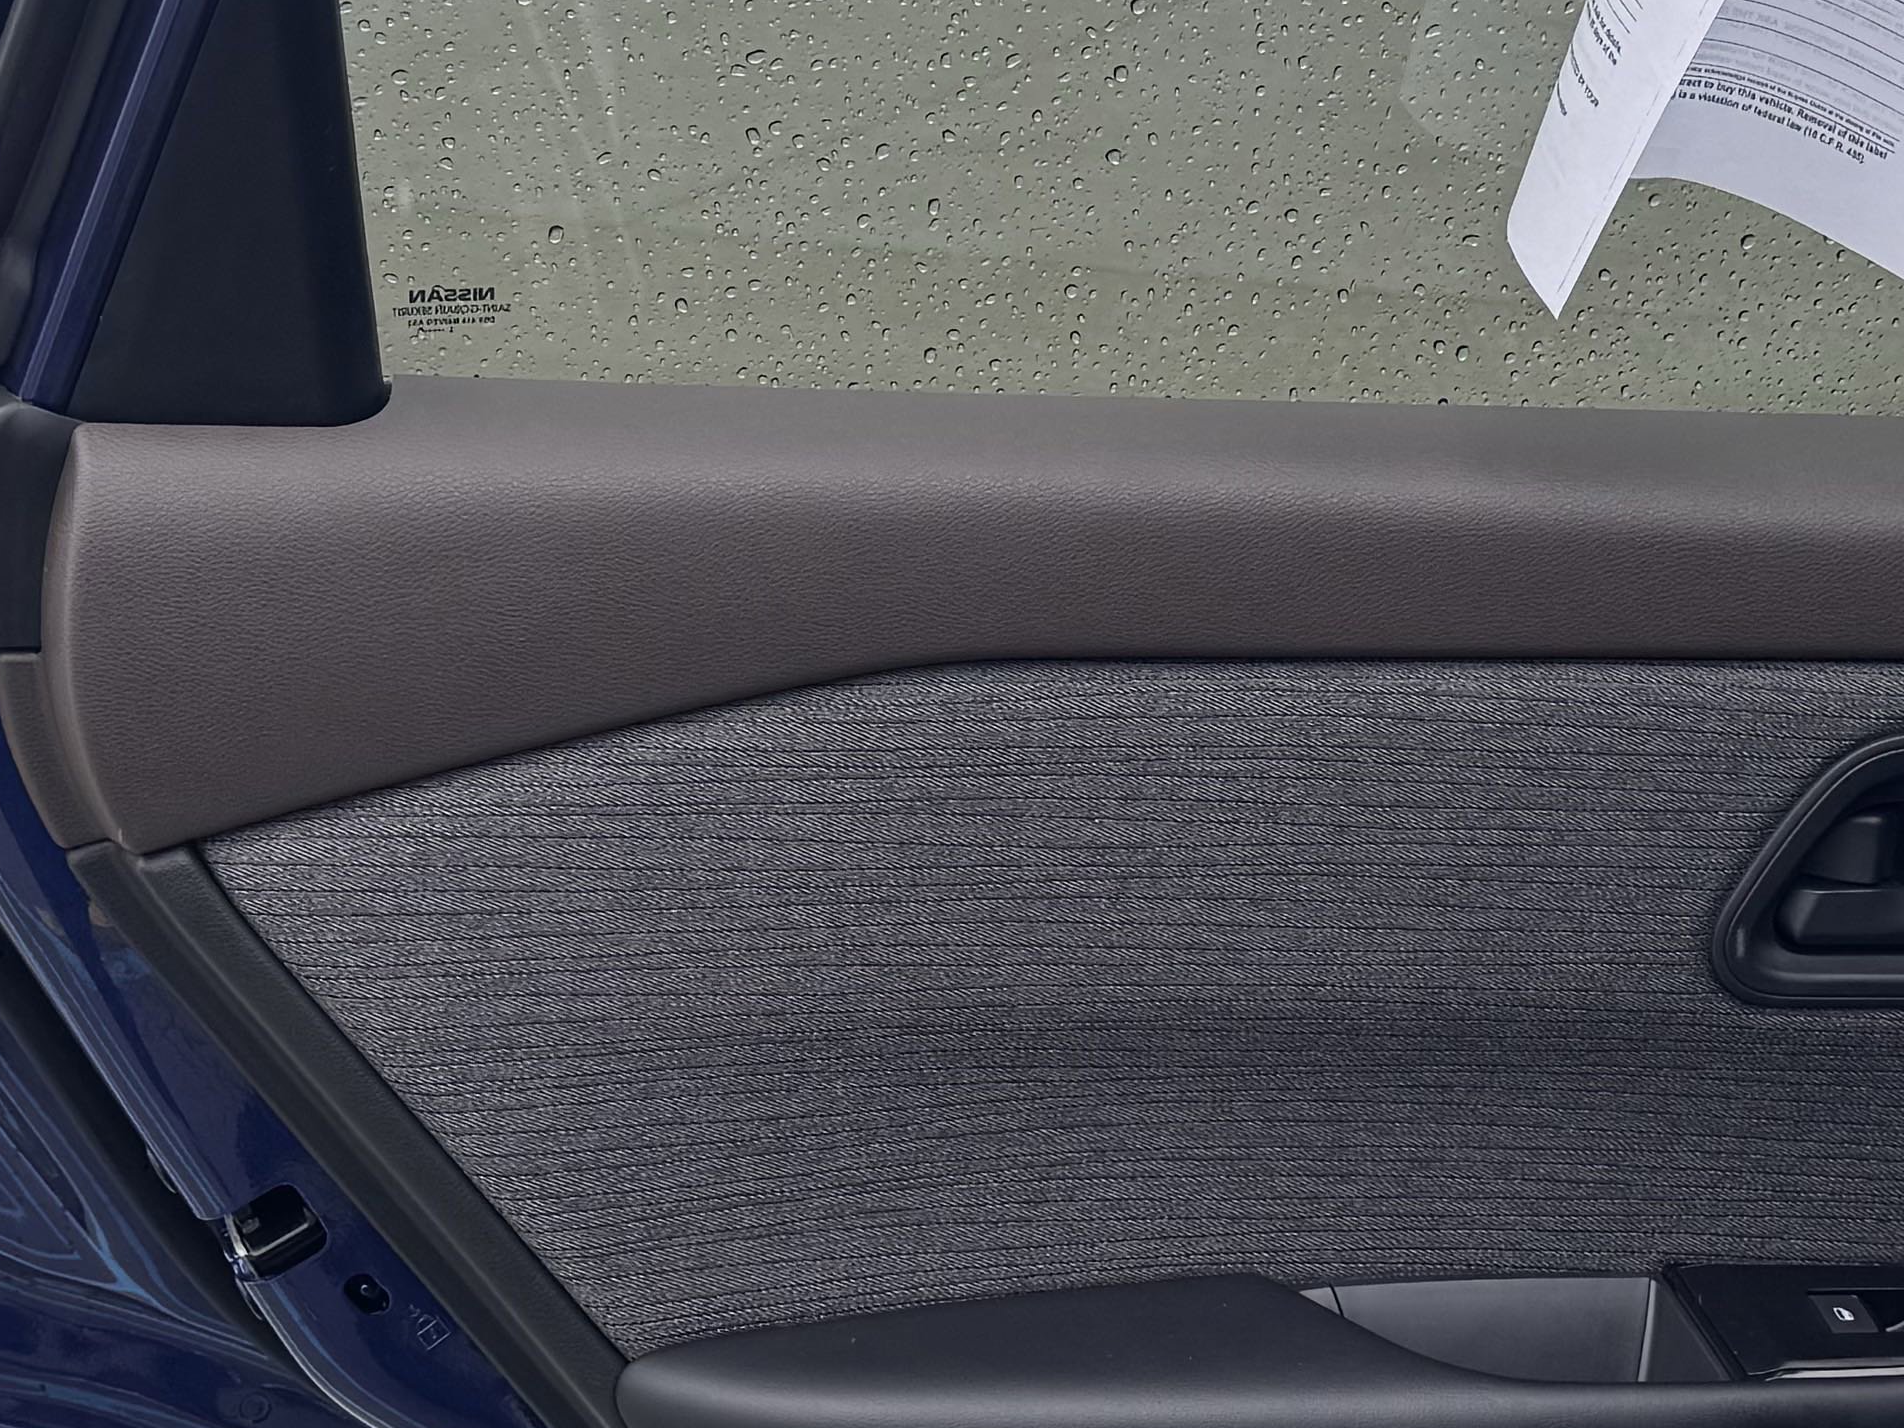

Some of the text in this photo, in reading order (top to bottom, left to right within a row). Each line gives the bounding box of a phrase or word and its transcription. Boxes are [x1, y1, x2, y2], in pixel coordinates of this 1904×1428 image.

[1698, 91, 1740, 111] violation
[1753, 105, 1786, 127] federal
[1716, 82, 1736, 96] buy
[1738, 86, 1756, 101] this
[1797, 108, 1836, 134] Removal
[1848, 131, 1865, 148] this
[1865, 141, 1888, 161] label
